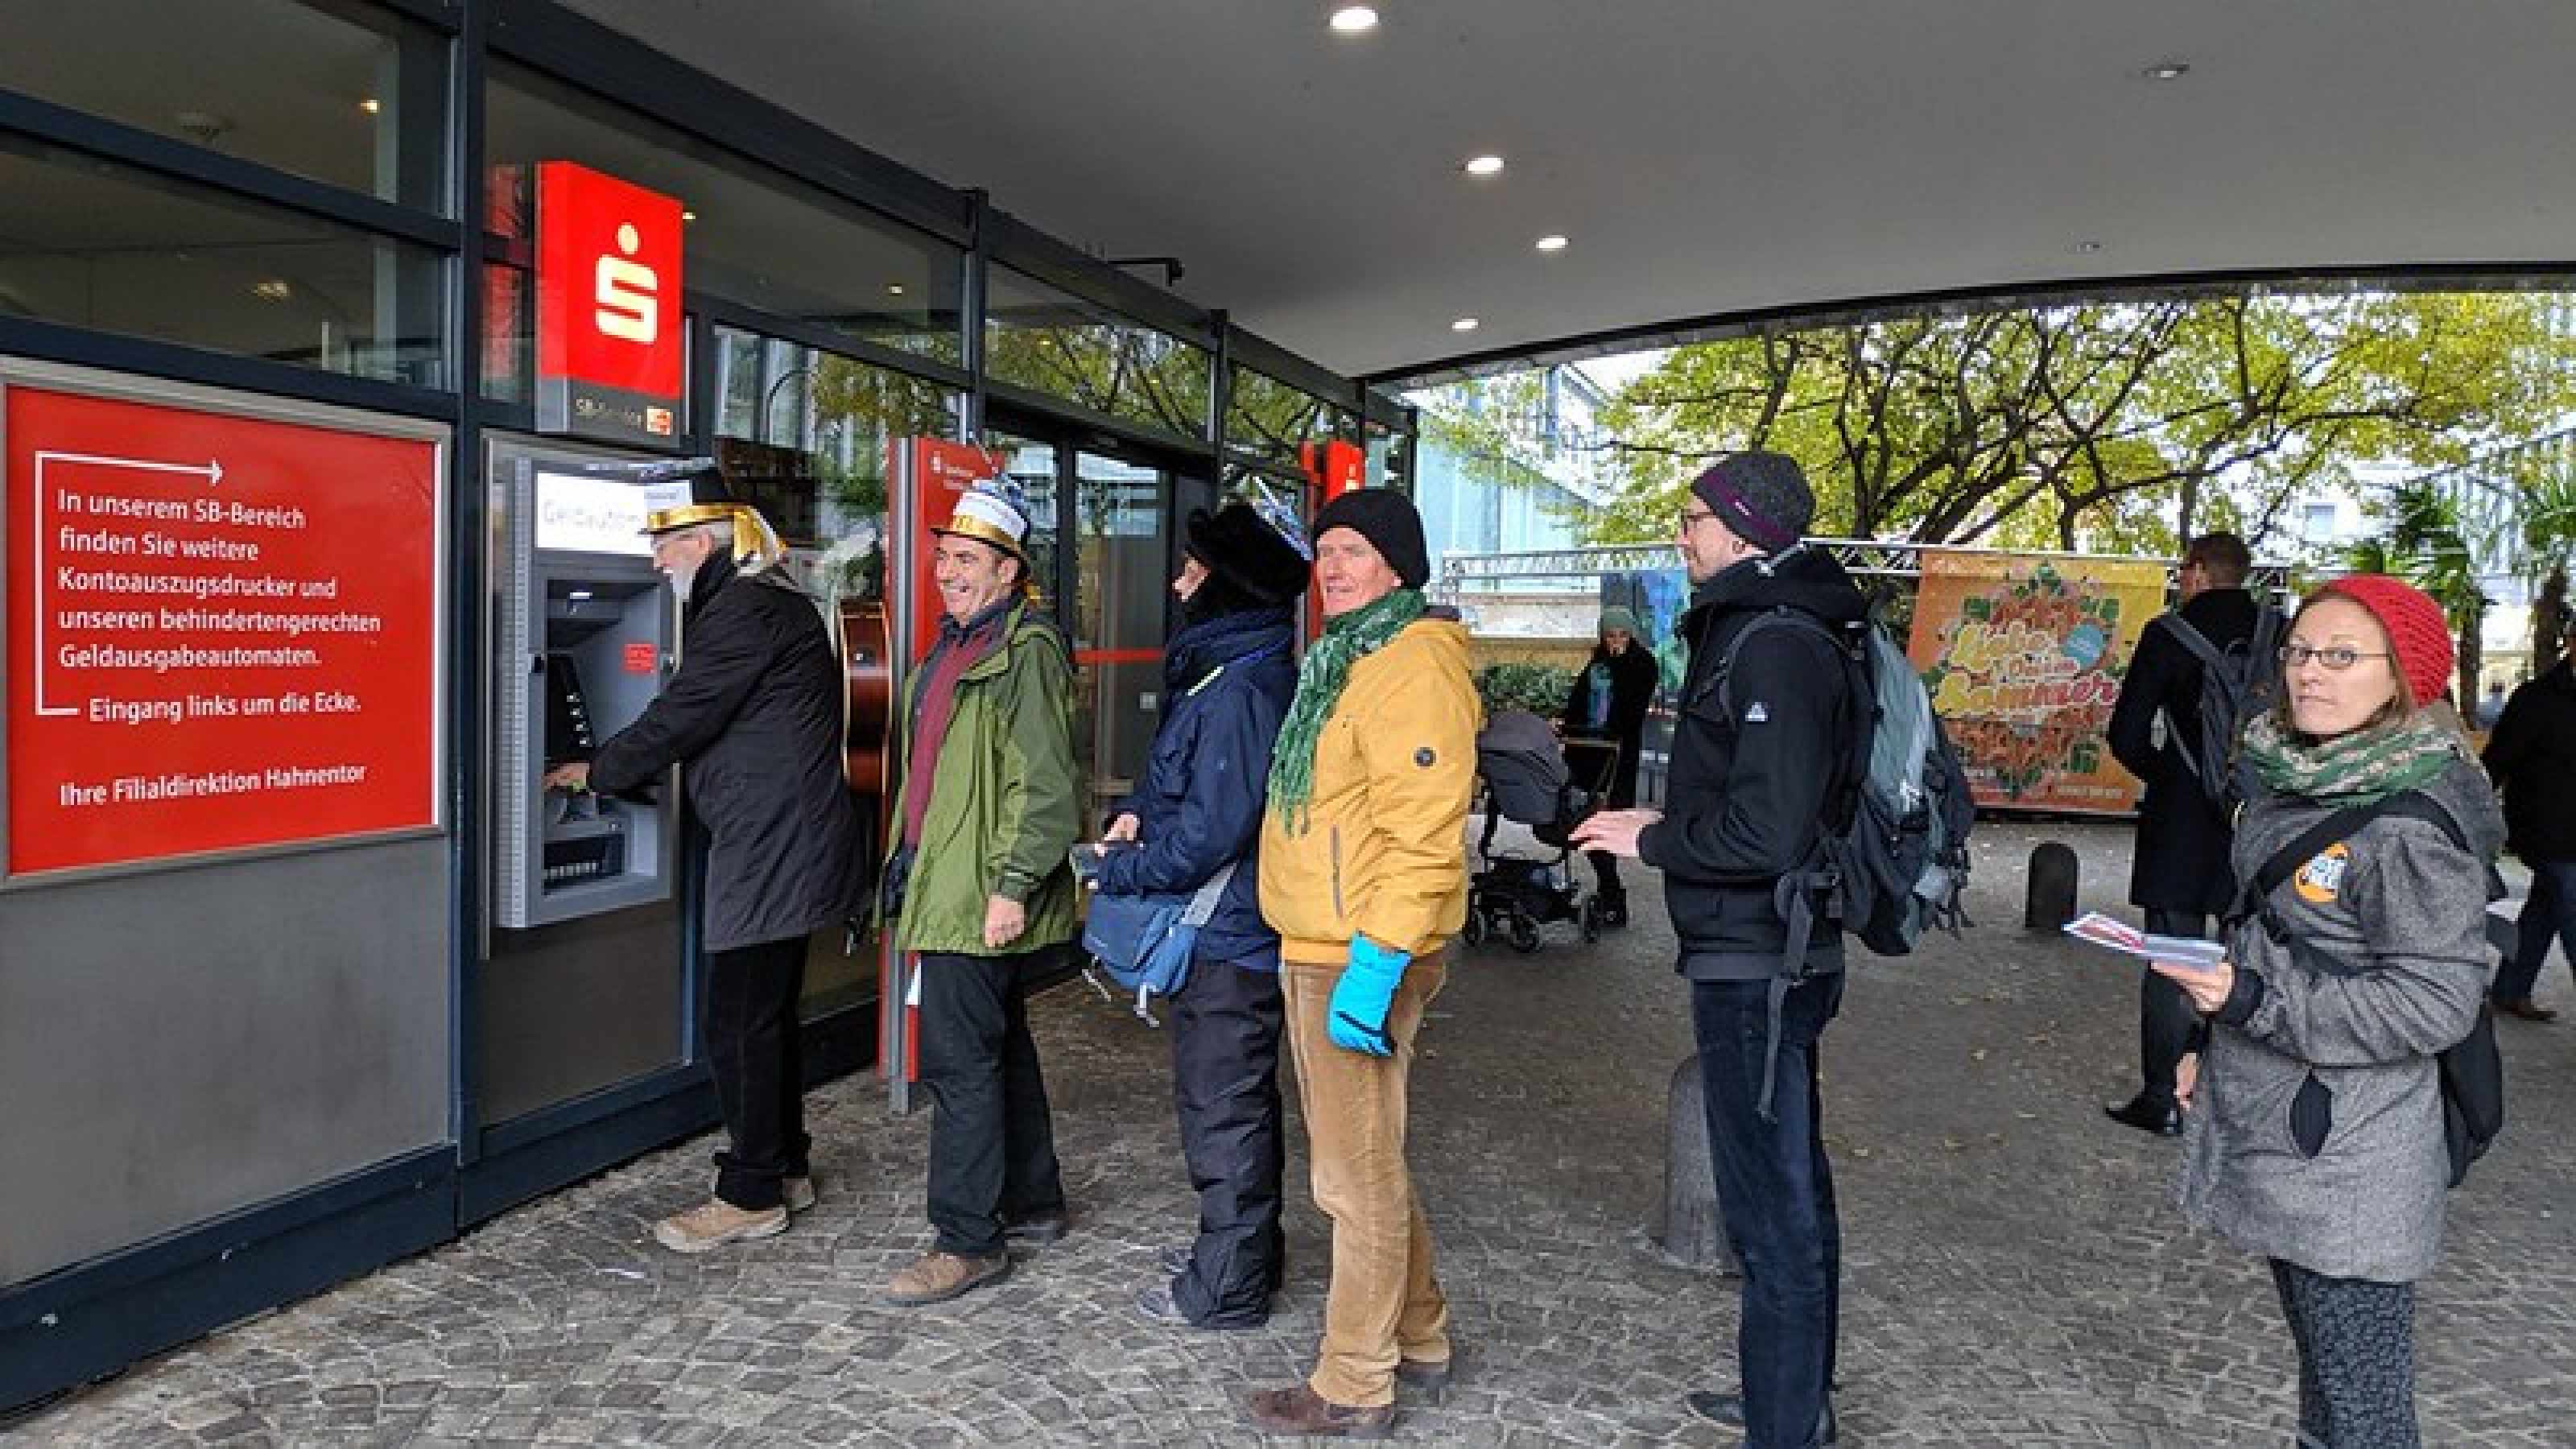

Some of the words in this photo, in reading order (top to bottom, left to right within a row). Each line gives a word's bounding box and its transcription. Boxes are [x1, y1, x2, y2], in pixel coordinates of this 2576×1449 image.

[58, 489, 81, 513] In
[89, 496, 188, 521] unserem
[193, 499, 307, 529] SB-Bereich
[60, 525, 136, 555] finden
[141, 531, 175, 557] Sie
[180, 537, 258, 561] weitere
[58, 567, 296, 600] Kontoauszugsdrucker
[299, 577, 336, 599] und
[58, 610, 155, 631] unseren
[160, 608, 381, 638] behindertengerechten
[58, 644, 322, 674] Geldausgabeautomaten.
[89, 696, 182, 724] Eingang
[187, 695, 238, 718] links
[241, 698, 275, 716] um
[279, 691, 310, 714] die
[315, 691, 362, 712] Ecke.
[60, 782, 107, 806] Ihre
[114, 770, 262, 802] Filialdirektion
[265, 765, 366, 790] Hahnentor
